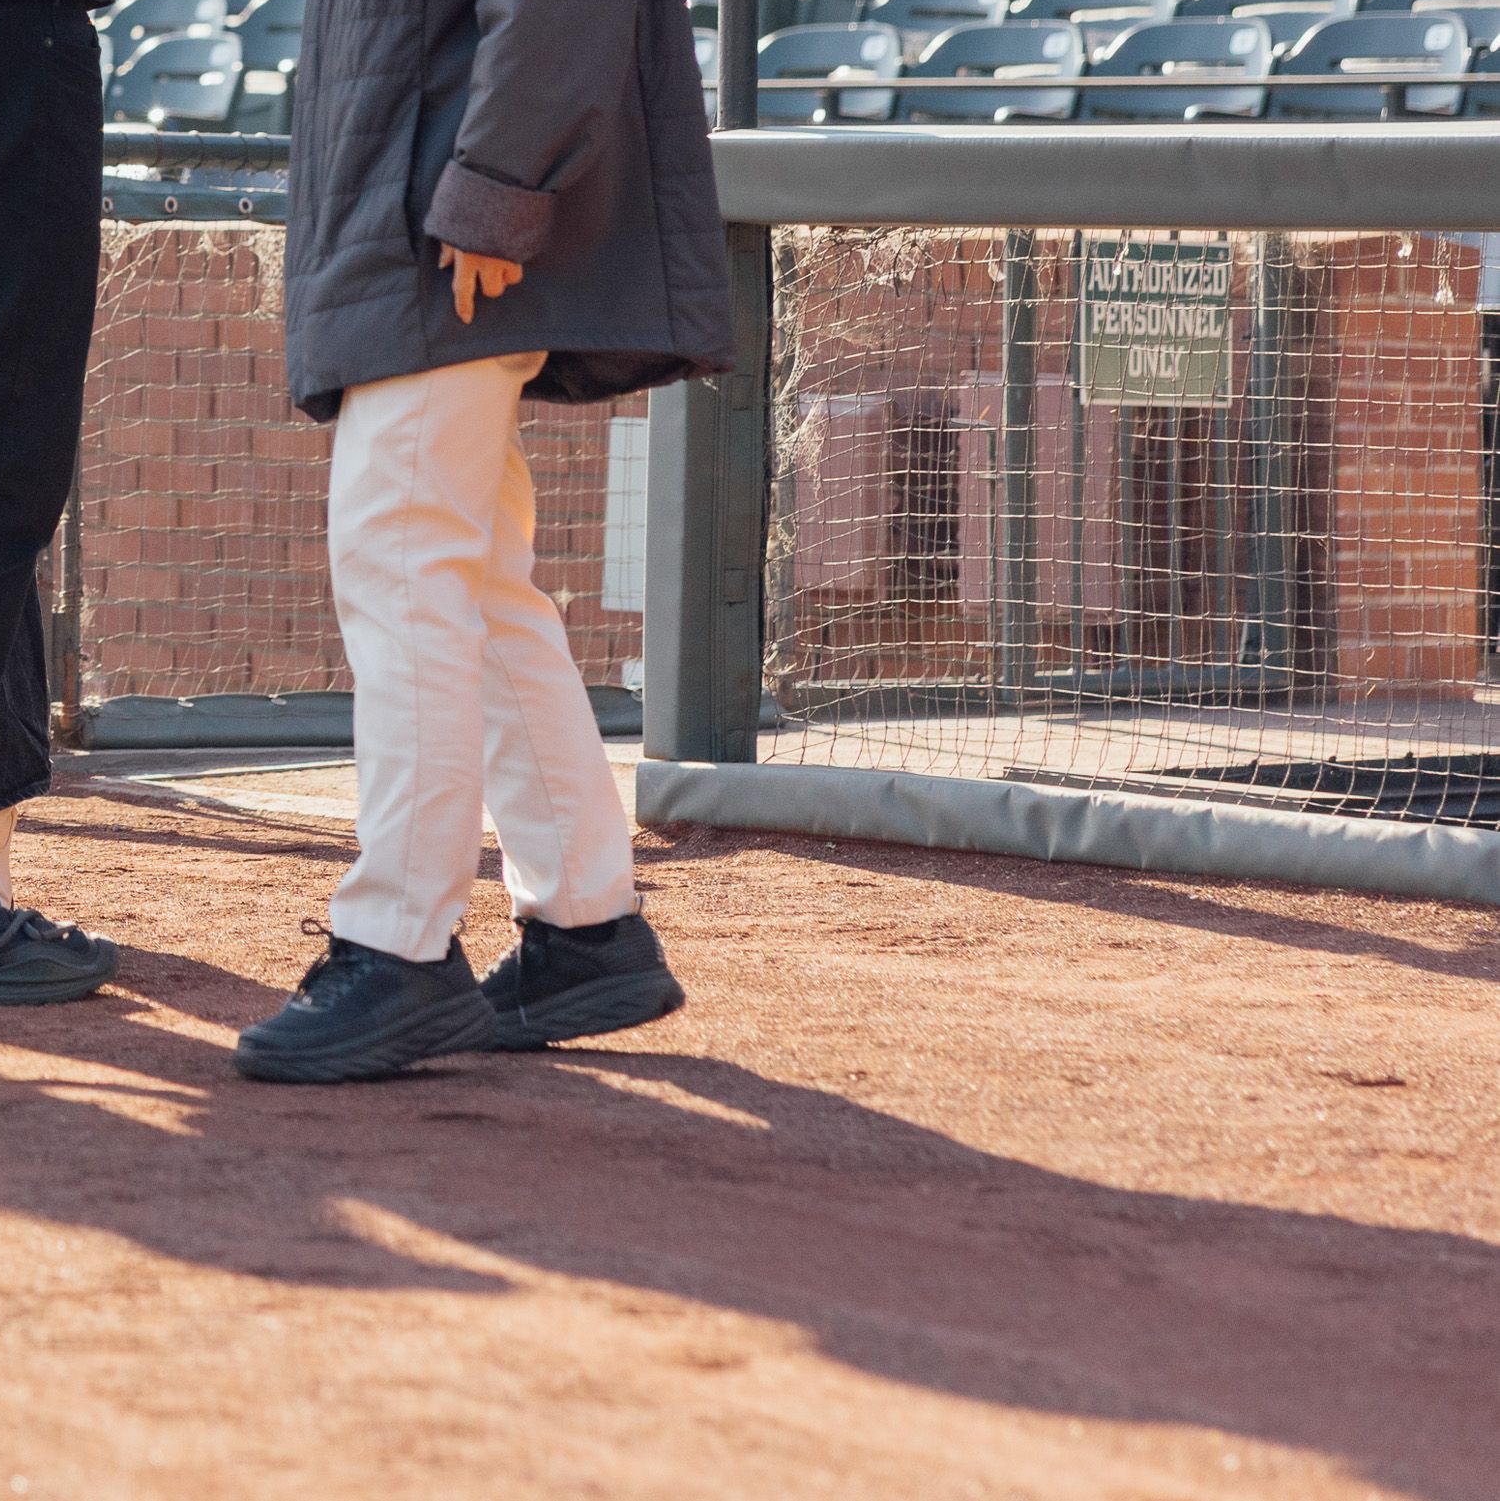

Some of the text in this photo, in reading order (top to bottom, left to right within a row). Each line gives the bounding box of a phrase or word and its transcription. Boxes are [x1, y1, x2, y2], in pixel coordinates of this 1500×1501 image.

[1088, 259, 1228, 297] AUTHORIZED
[1092, 300, 1223, 339] PERSONNEL
[1128, 343, 1185, 379] ONLY
